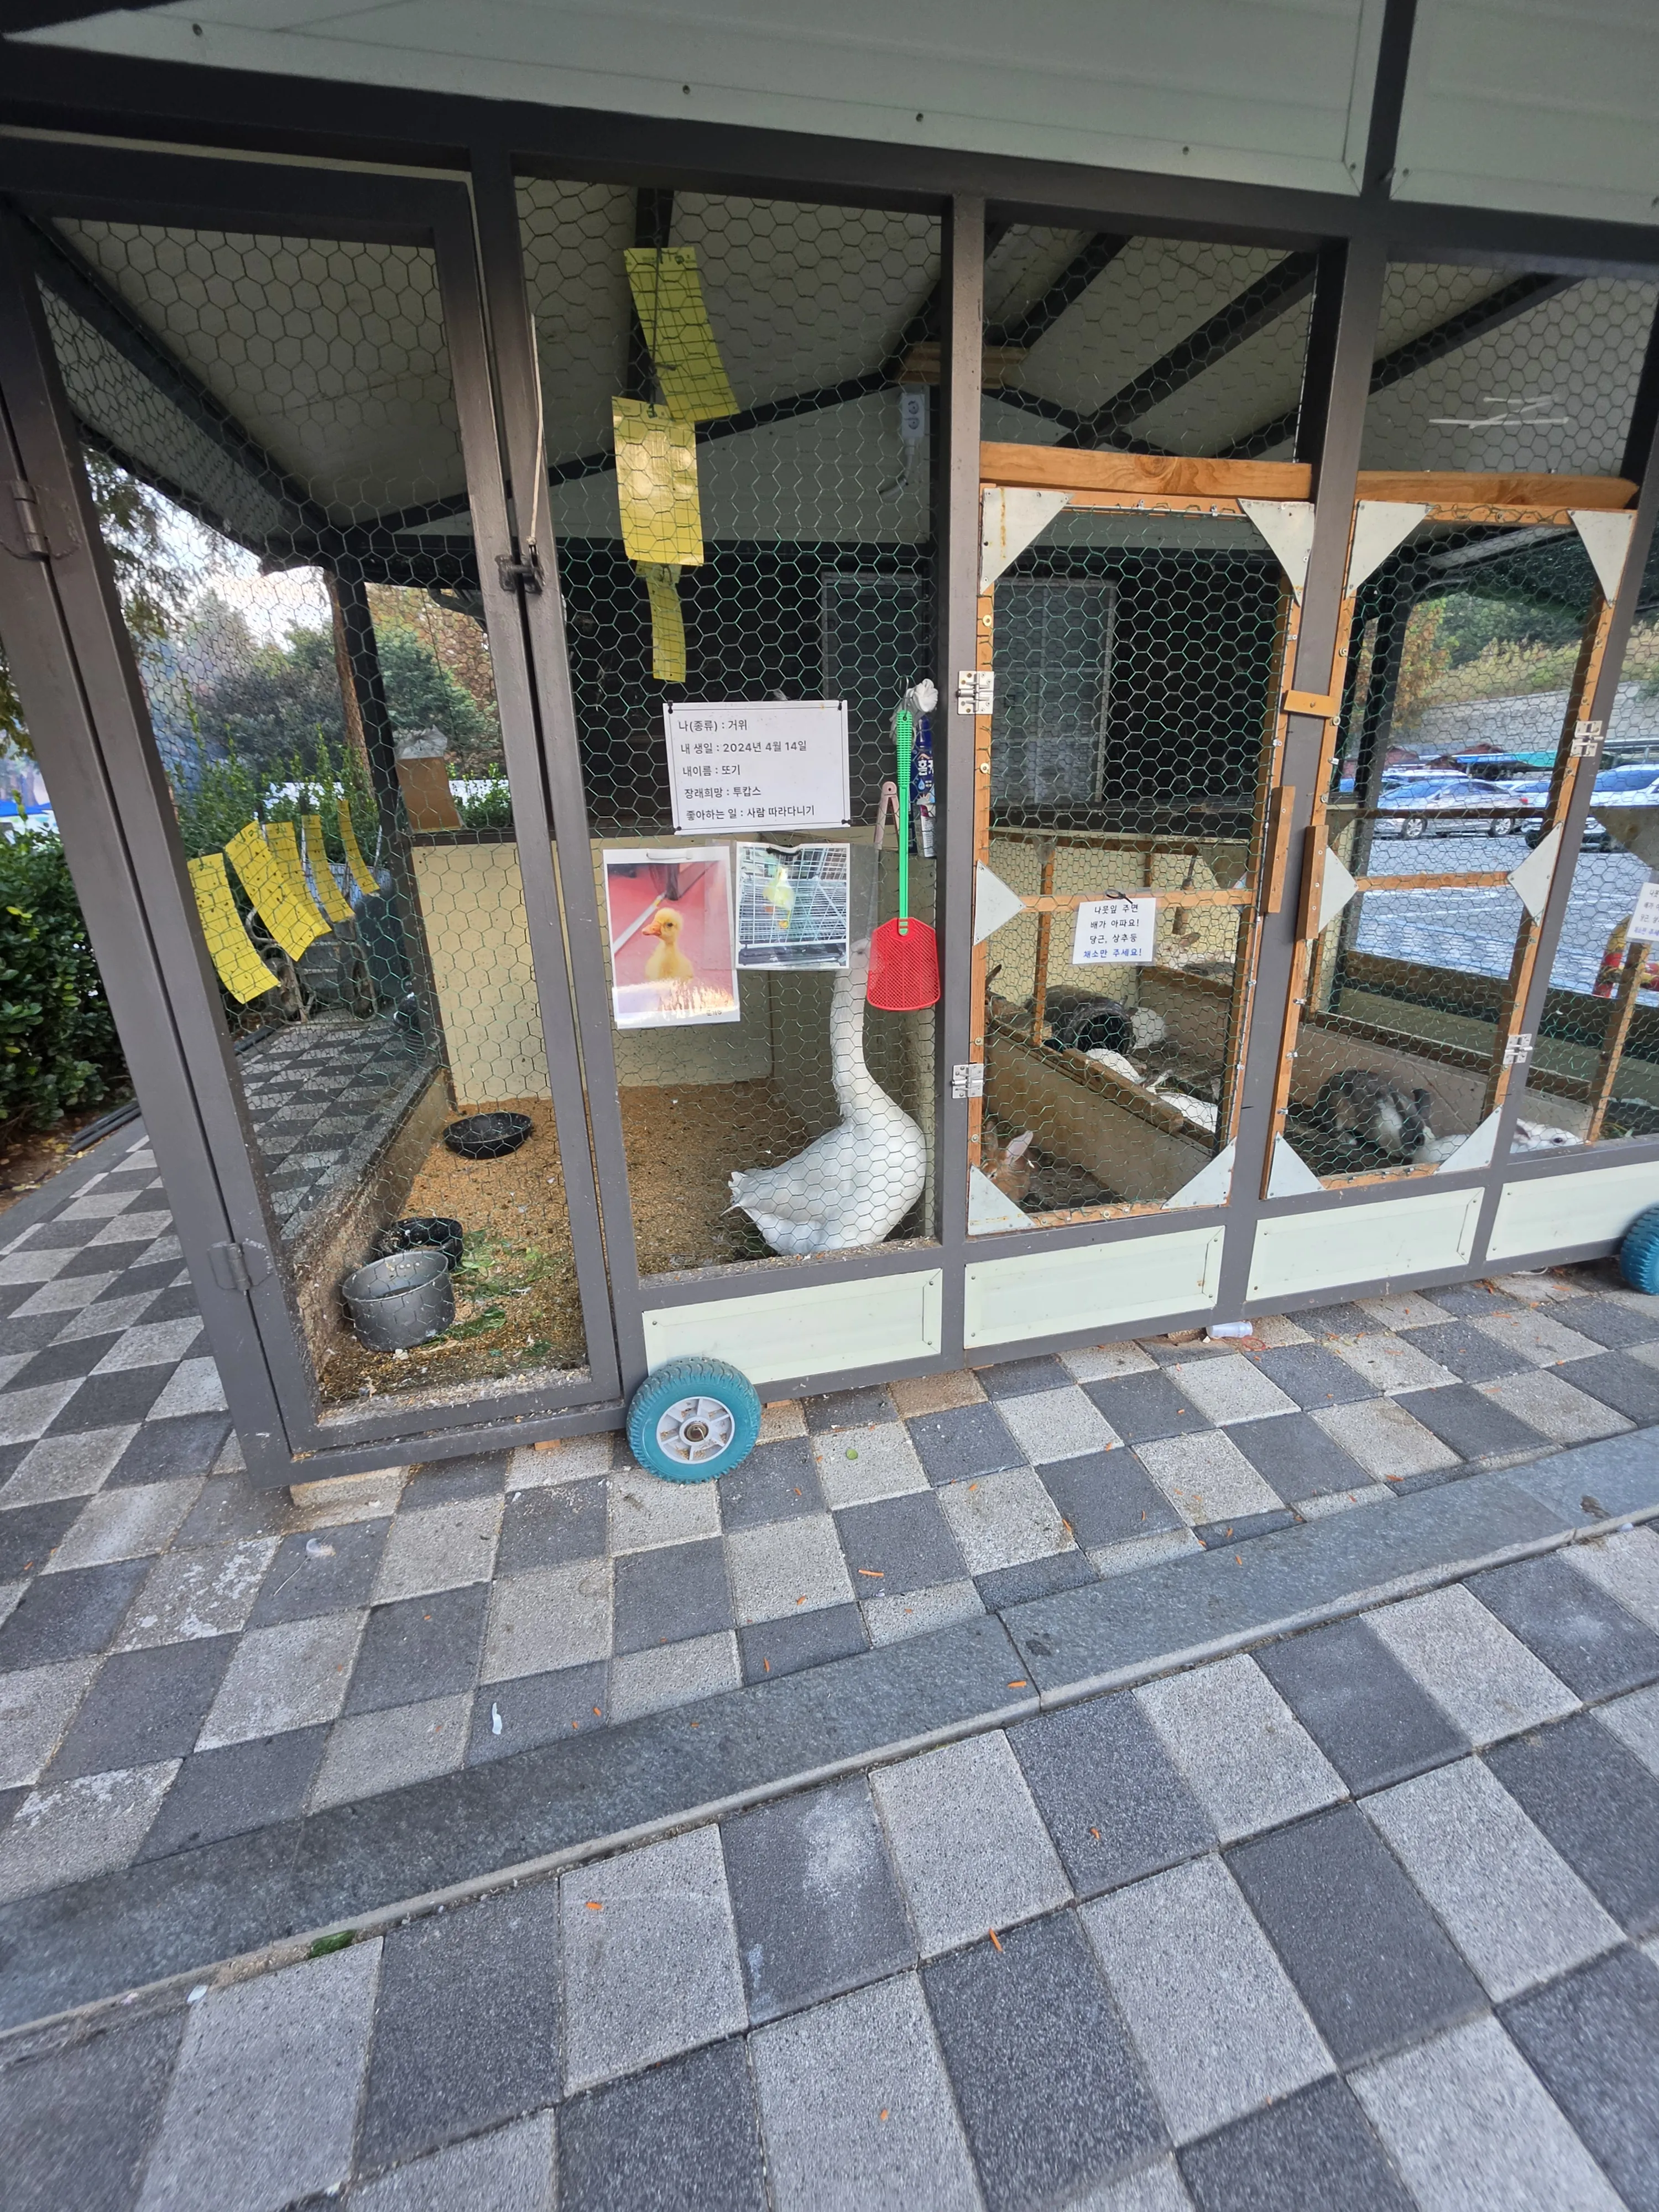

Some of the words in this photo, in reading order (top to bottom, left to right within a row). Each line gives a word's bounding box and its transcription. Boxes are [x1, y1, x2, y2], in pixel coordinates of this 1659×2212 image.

[679, 720, 718, 733] 나(종류)
[728, 719, 747, 731] 거위
[681, 743, 690, 755] 내
[693, 743, 713, 754] 생일
[723, 742, 761, 753] 2024년
[765, 741, 781, 752] 4월
[785, 740, 806, 752] 14일
[682, 765, 712, 777] 내이름
[722, 764, 740, 775] 또기
[684, 787, 723, 799] 장래희망
[733, 786, 761, 797] 투캅스
[686, 809, 725, 821] 좋아하는
[728, 808, 737, 819] 일
[747, 807, 765, 818] 사람
[768, 805, 815, 817] 따라다니기
[1094, 905, 1117, 914] 나뭇잎
[1110, 919, 1139, 927] 아파요!
[1112, 933, 1138, 943] 상추등
[1083, 950, 1108, 958] 채소만
[1113, 948, 1142, 957] 주세요!
